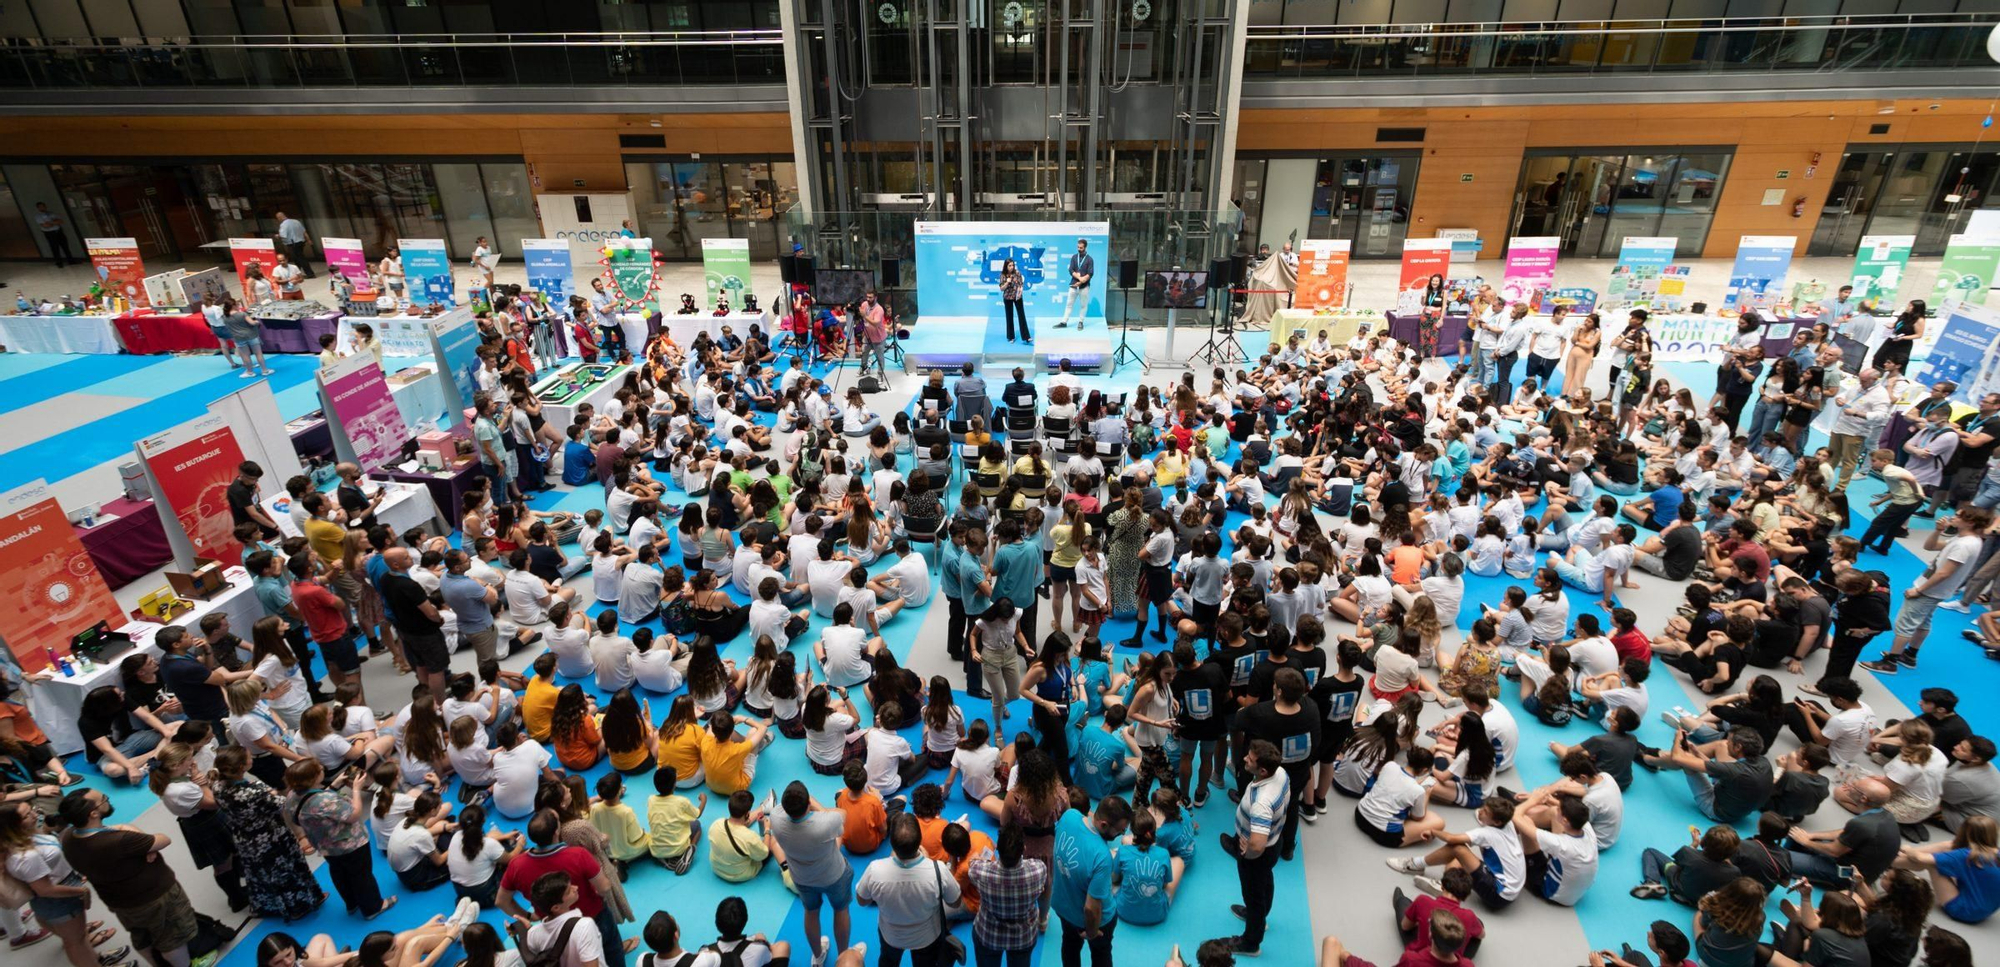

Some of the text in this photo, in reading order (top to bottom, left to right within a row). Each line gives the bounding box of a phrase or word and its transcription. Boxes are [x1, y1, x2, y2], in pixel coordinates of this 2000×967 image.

[557, 229, 621, 243] endesa
[173, 448, 222, 472] IES BUTARQUE
